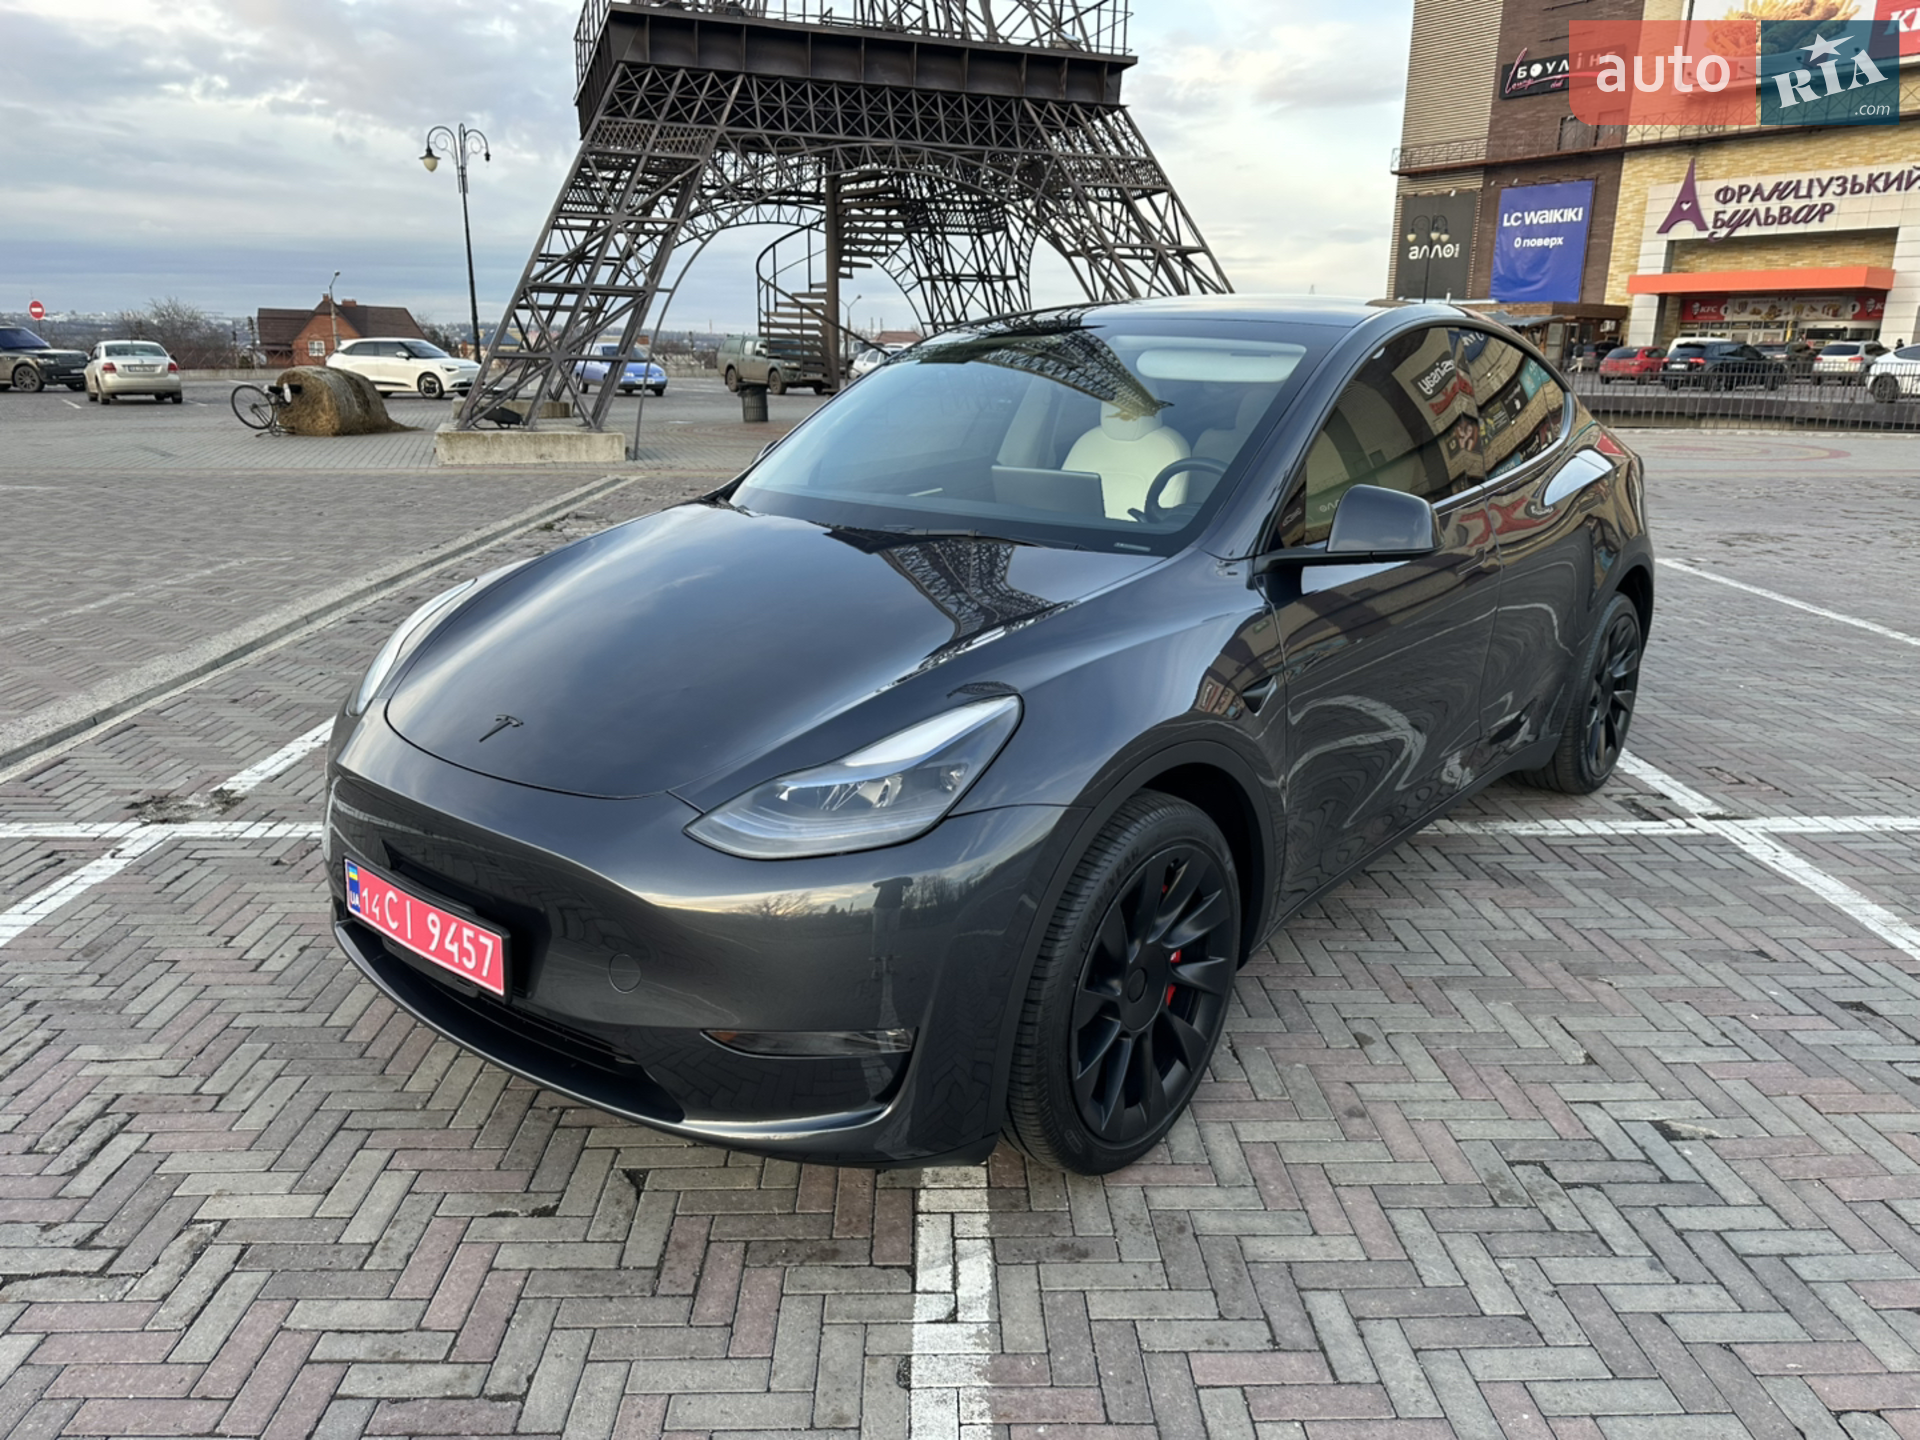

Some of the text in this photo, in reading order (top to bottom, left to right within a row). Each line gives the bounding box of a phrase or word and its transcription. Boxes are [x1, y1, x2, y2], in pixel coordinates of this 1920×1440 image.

[1502, 212, 1523, 227] LC
[1523, 236, 1564, 249] поверх
[1700, 305, 1718, 313] KFC
[427, 912, 494, 977] 9457
